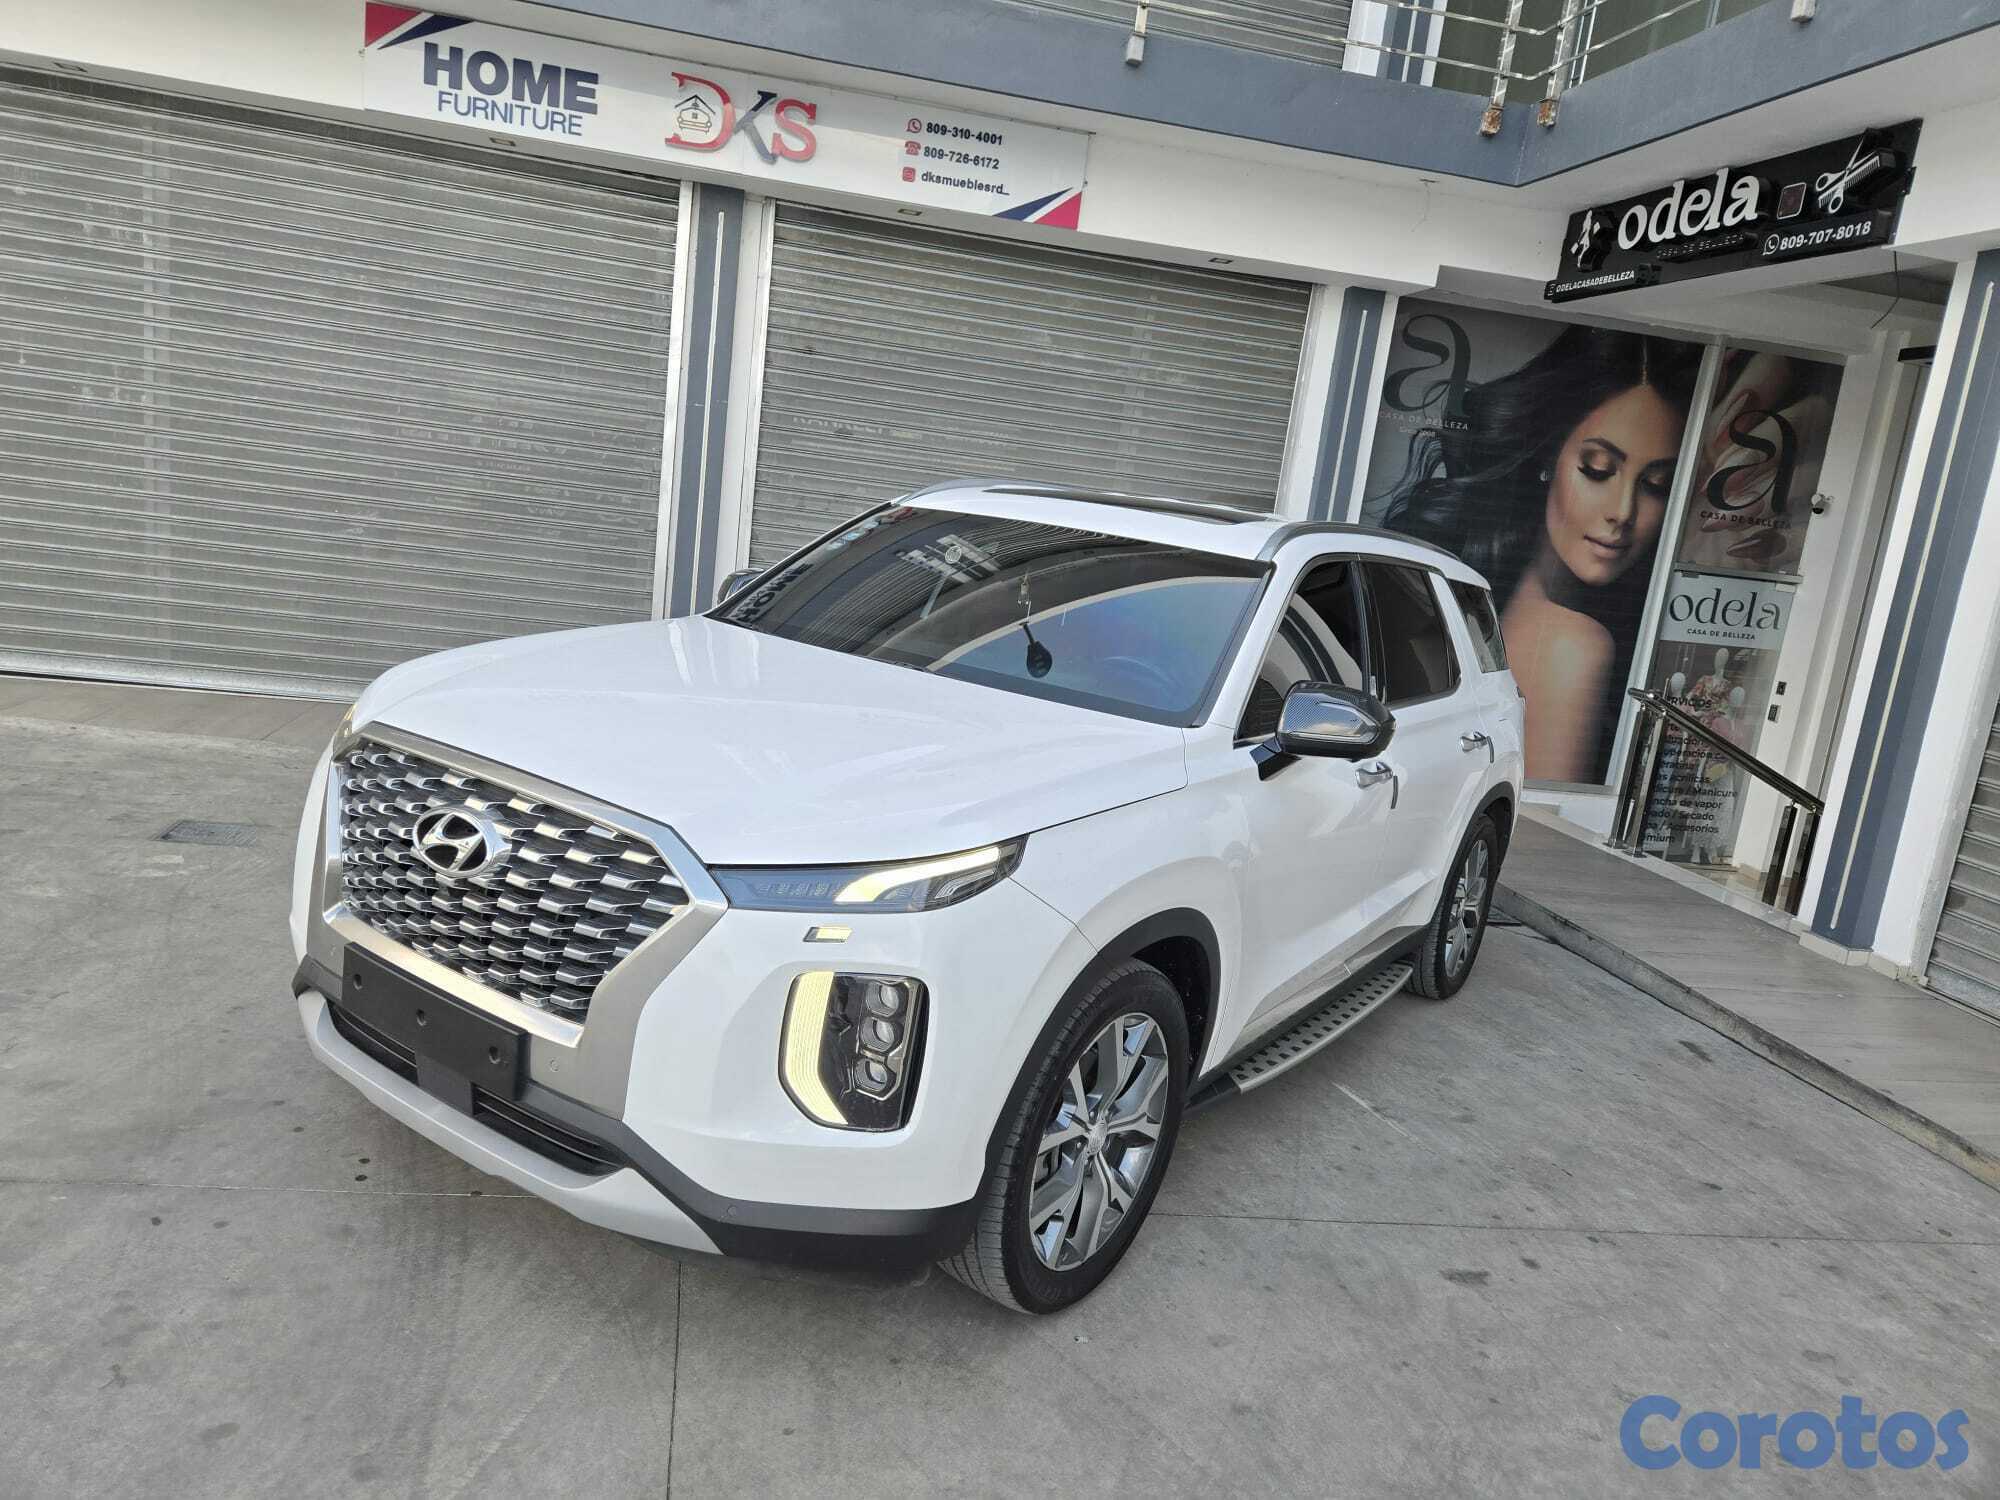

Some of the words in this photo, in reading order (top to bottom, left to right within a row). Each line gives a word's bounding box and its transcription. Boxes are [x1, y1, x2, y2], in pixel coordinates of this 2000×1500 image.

[423, 42, 599, 115] HOME
[437, 91, 583, 137] FURNITURE
[665, 71, 818, 164] DKS
[926, 122, 1013, 145] 809-310-4001
[923, 146, 1010, 170] 809-726-6172
[1617, 167, 1761, 250] odela
[1779, 220, 1872, 251] 809-707-8018
[1556, 270, 1635, 293] ODELACASADEBELLEZA
[1700, 510, 1726, 521] CASA
[1730, 514, 1745, 524] DE
[1669, 587, 1782, 630] odela
[1687, 628, 1707, 636] CASA
[1723, 631, 1756, 641] BELLEZA
[1695, 800, 1722, 810] vapor
